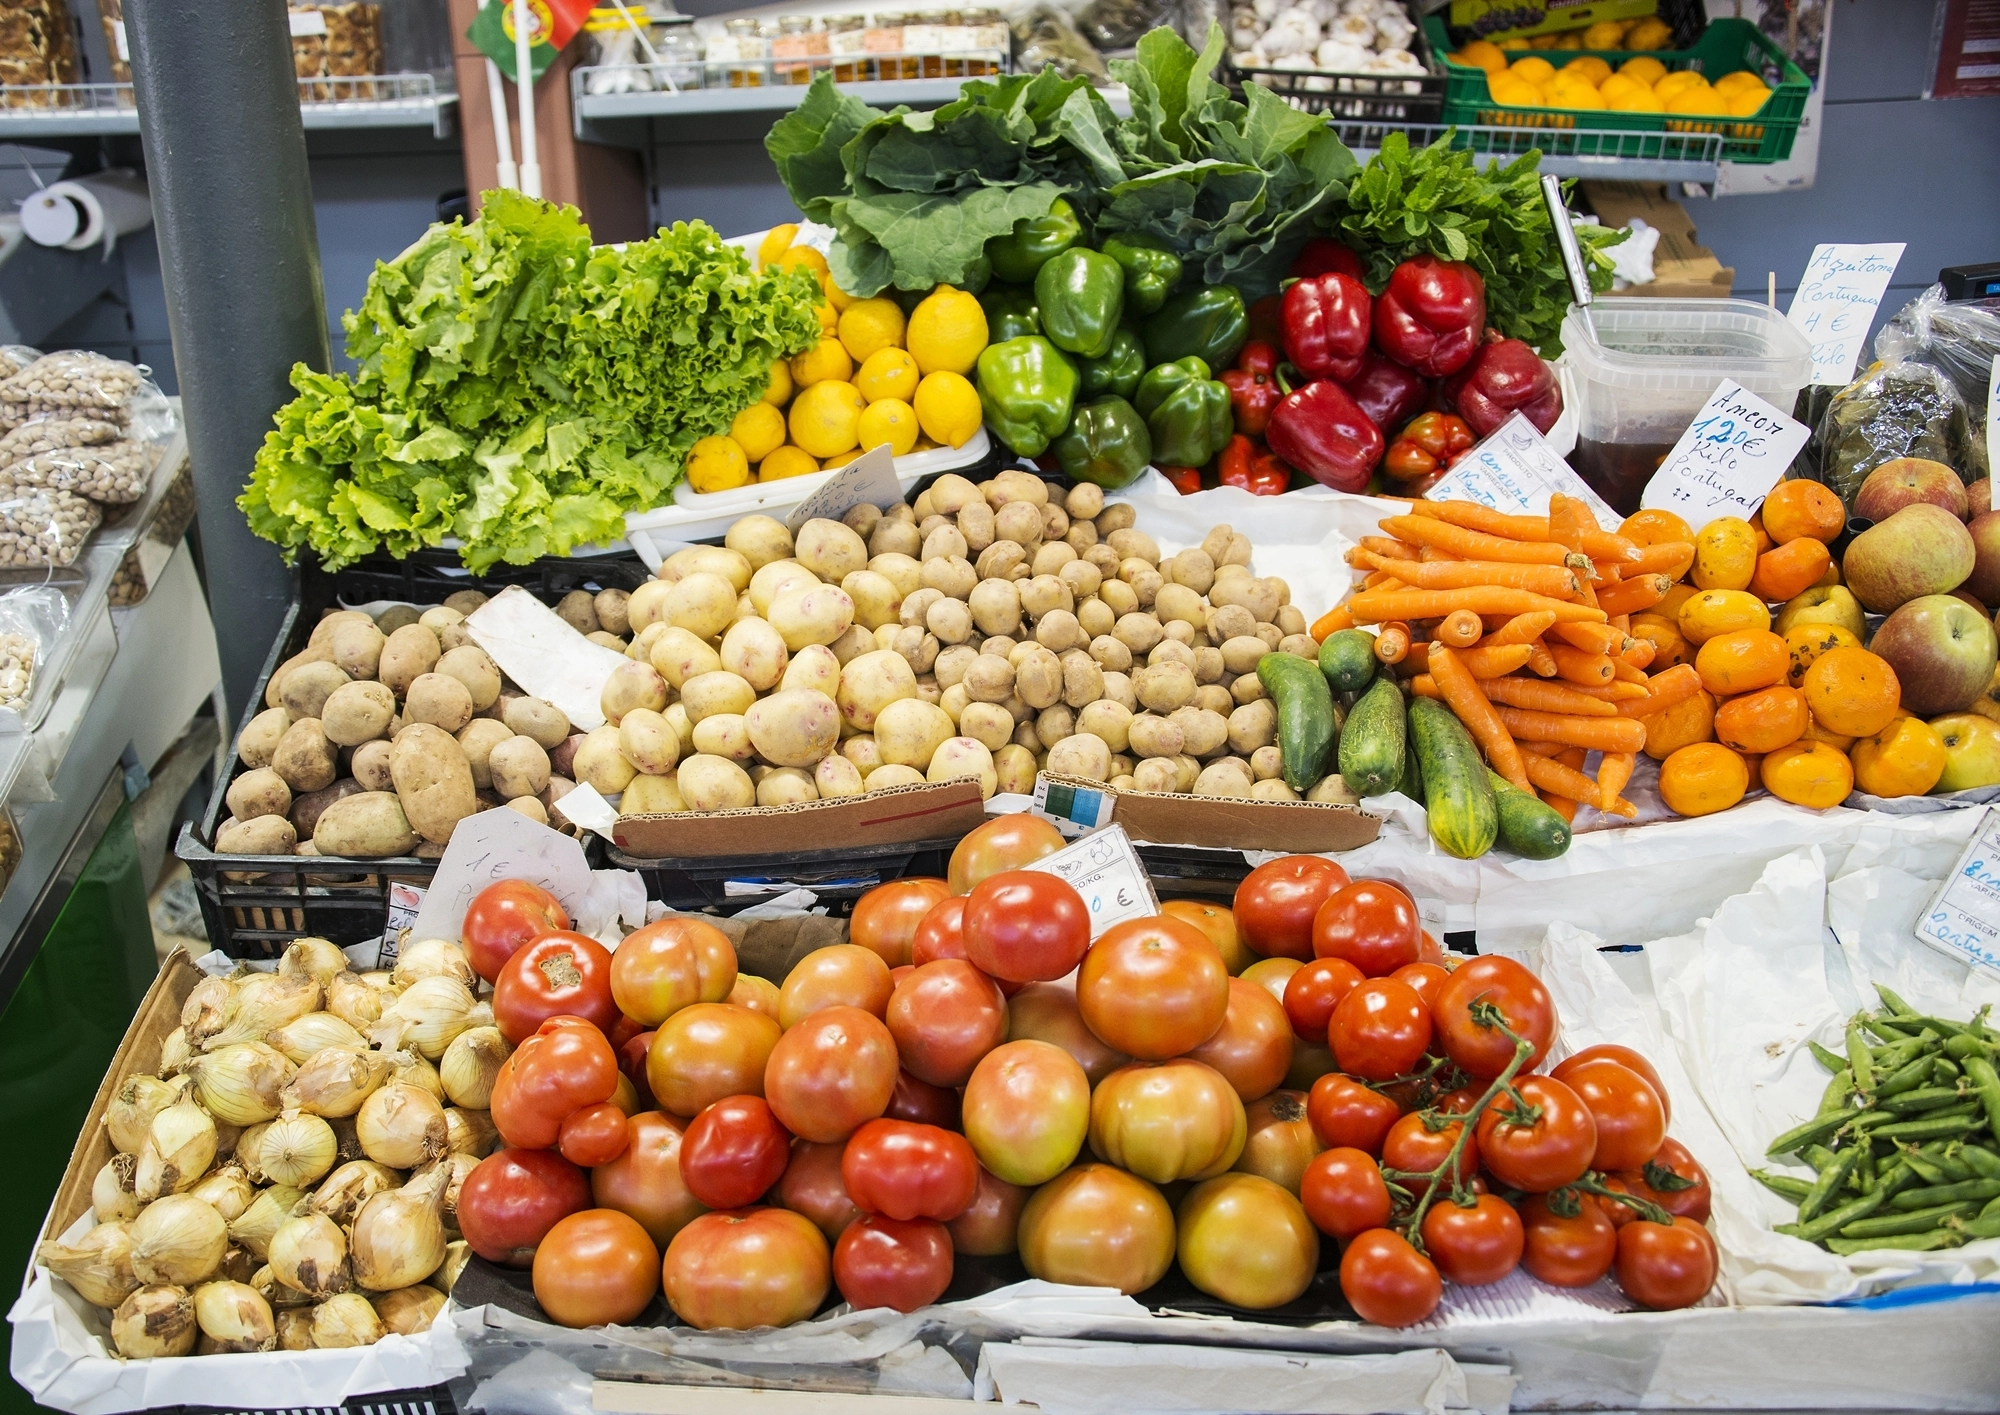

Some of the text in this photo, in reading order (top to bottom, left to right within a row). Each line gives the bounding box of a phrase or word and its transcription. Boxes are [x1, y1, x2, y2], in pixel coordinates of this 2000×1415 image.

[1831, 314, 1851, 331] €
[1503, 448, 1533, 479] PRODUTO
[1455, 469, 1498, 511] Nant
[1479, 465, 1513, 501] VARIEDADE
[1957, 913, 1998, 938] ORIGEM
